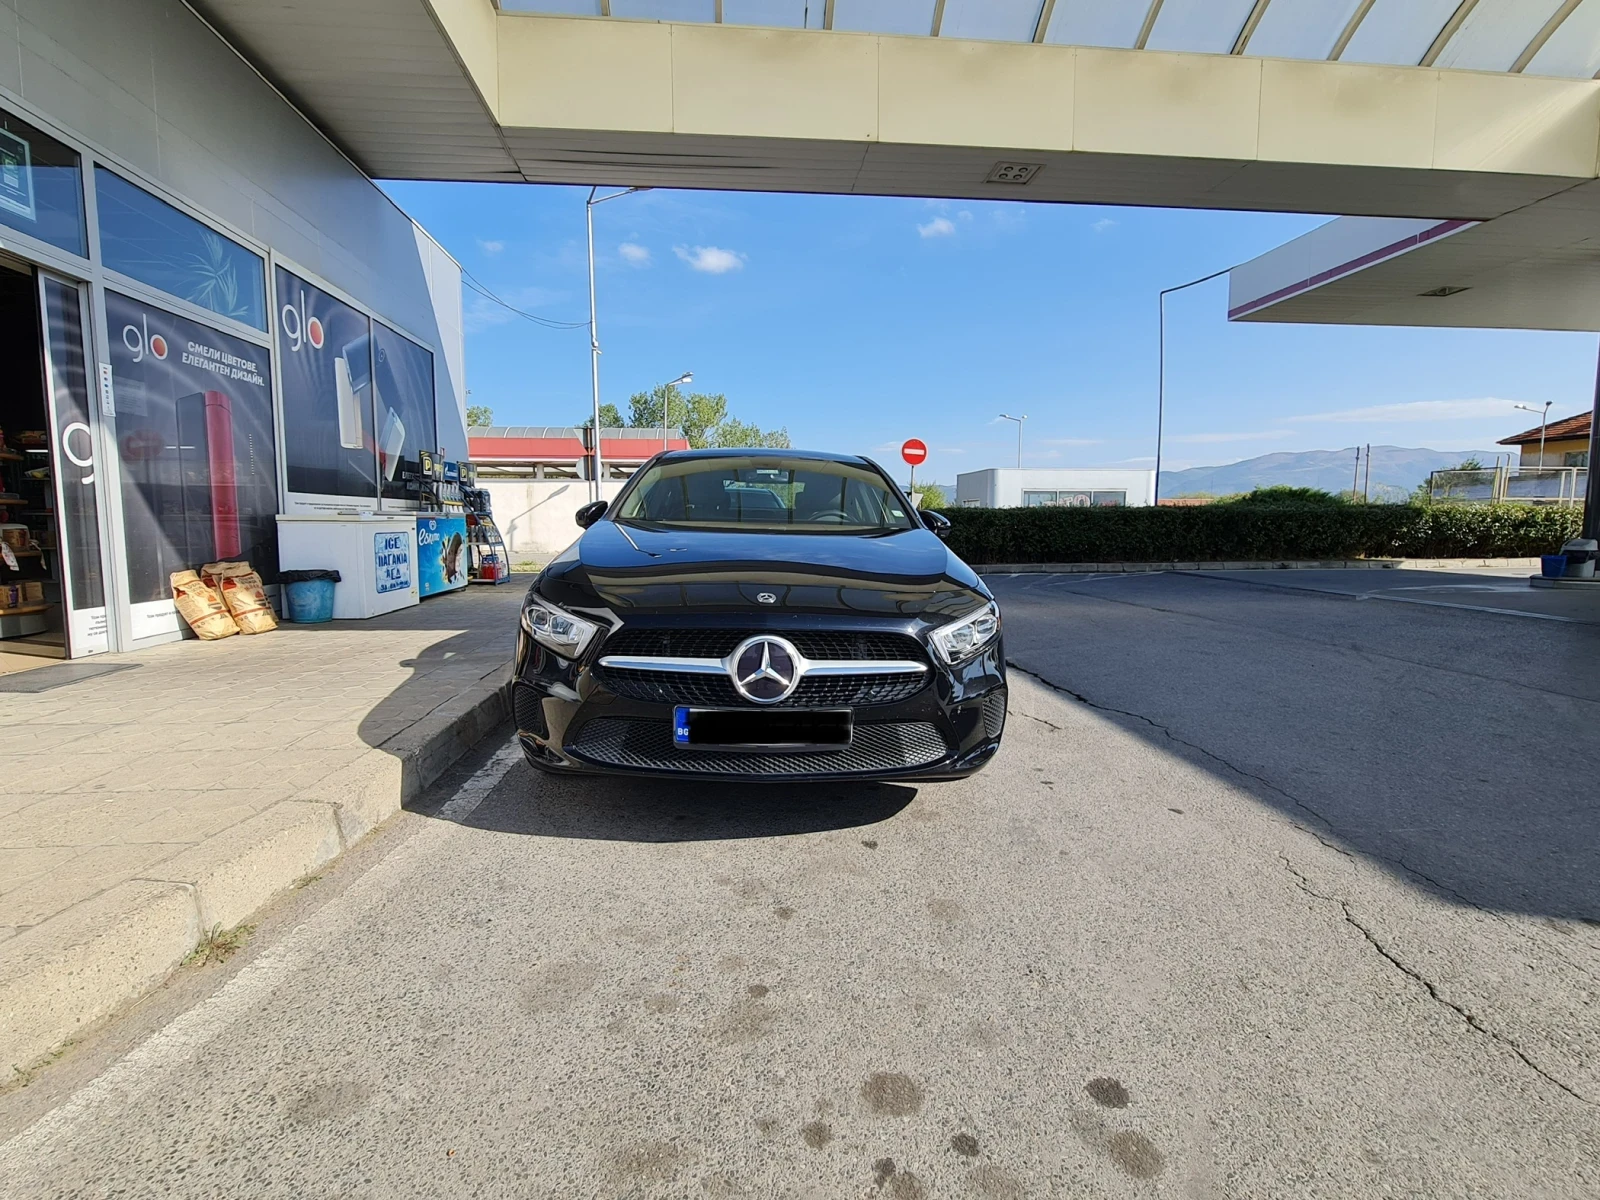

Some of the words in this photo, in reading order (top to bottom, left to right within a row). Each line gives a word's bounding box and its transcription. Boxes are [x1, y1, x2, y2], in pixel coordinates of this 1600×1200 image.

[282, 289, 325, 352] glo
[122, 313, 168, 363] glo
[181, 352, 231, 376] ЕЛЕГАНТЕН
[187, 341, 221, 361] СМЕЛИ
[221, 350, 258, 373] ЦВЕТОВЕ.
[385, 536, 401, 550] ICE
[677, 727, 689, 736] BG
